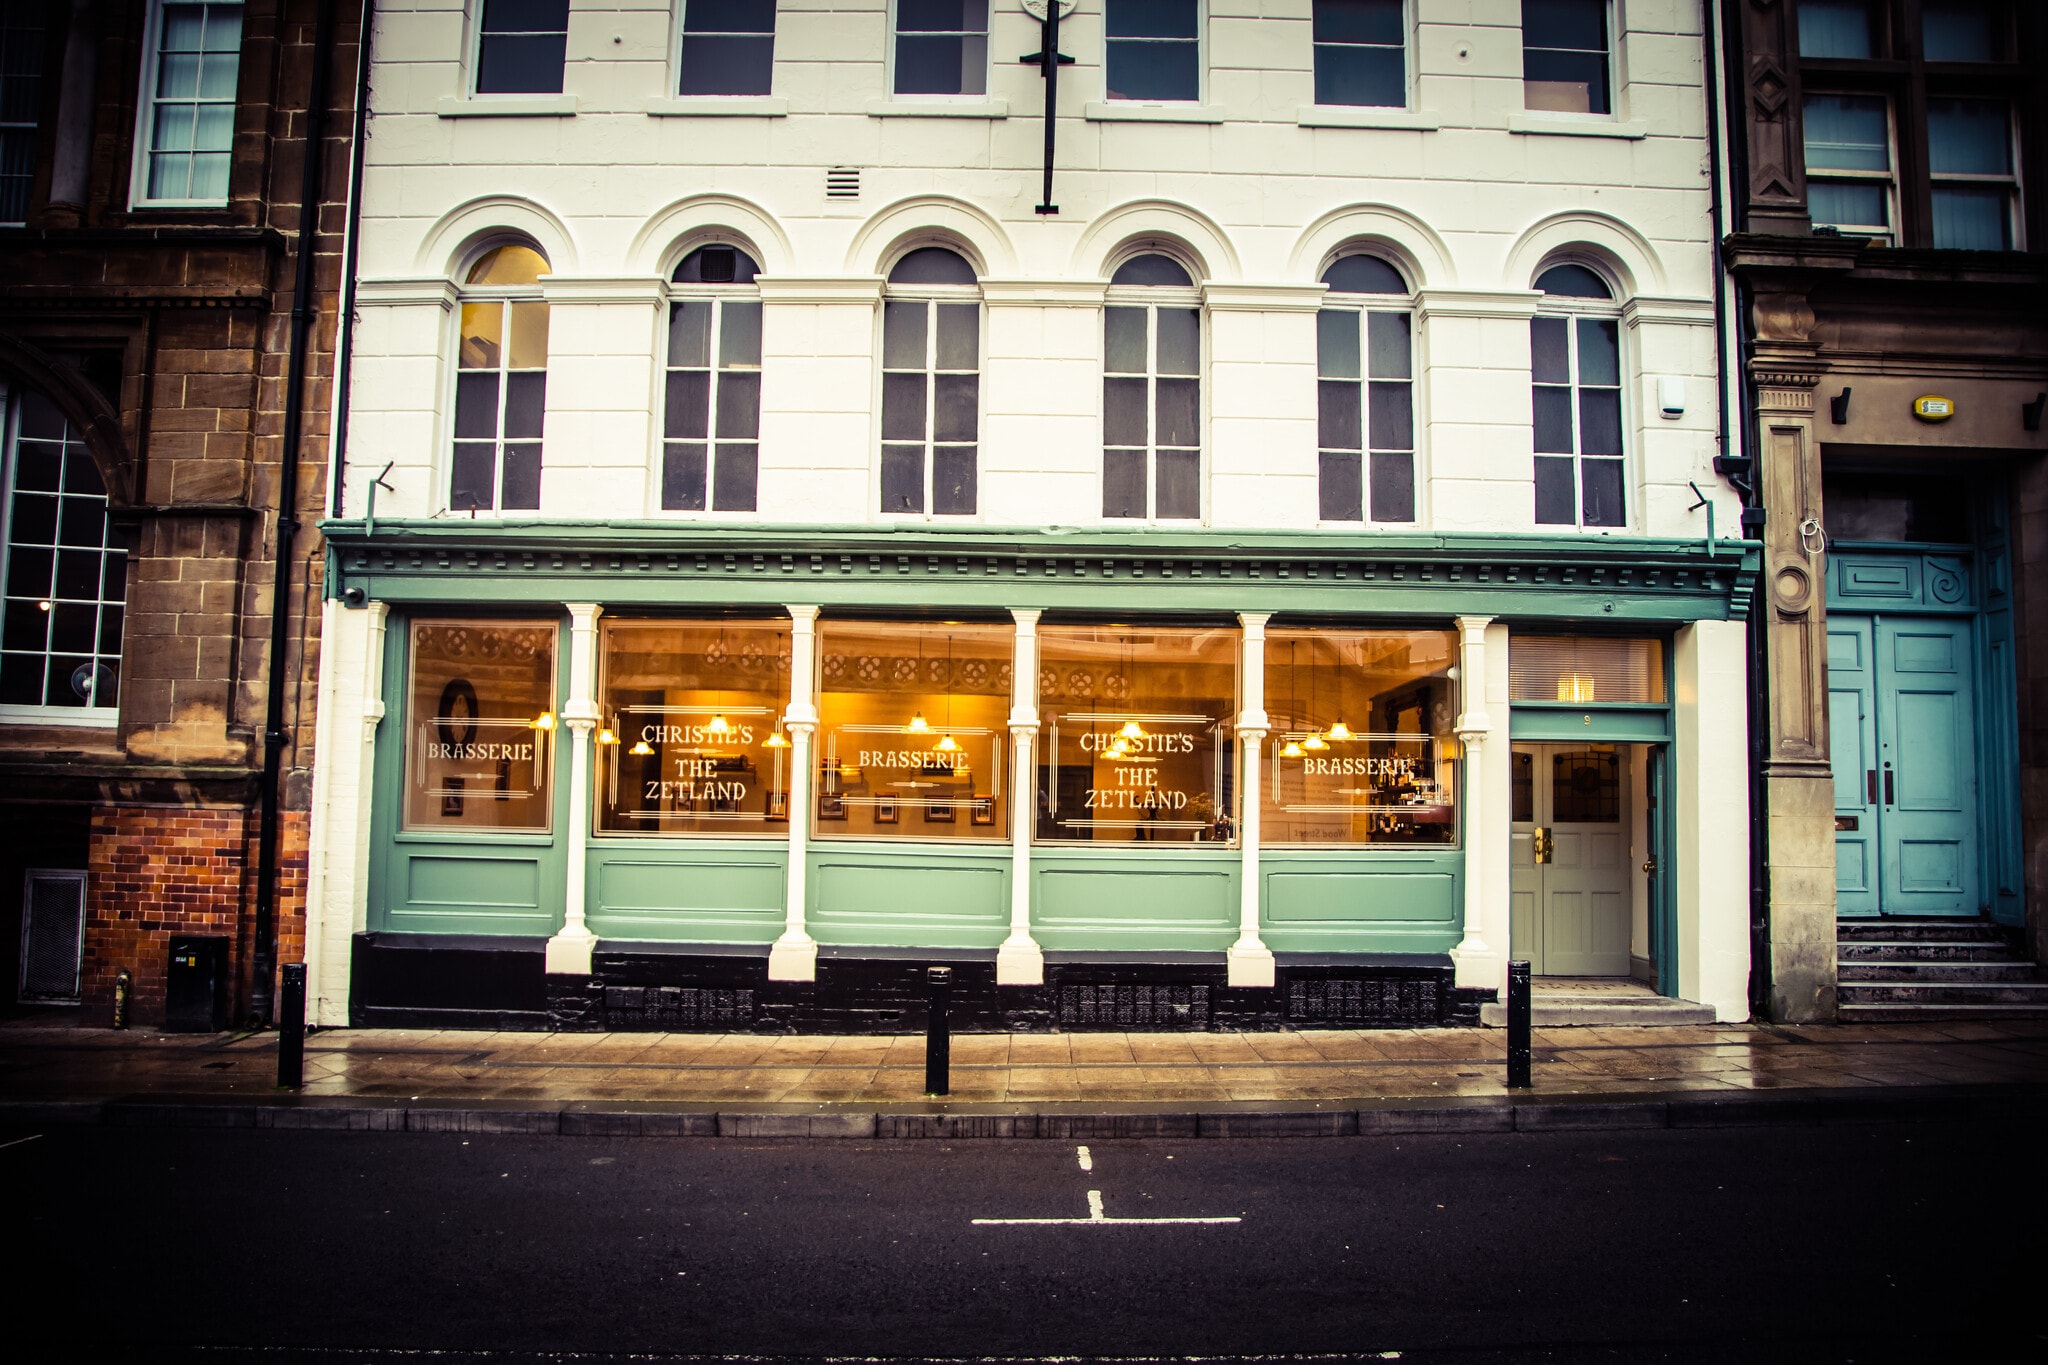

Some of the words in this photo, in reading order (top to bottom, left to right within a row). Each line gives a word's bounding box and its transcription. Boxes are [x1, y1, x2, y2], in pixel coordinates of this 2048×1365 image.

[1584, 715, 1591, 728] 9
[428, 742, 533, 761] BRASSERIE
[1079, 731, 1195, 754] CHSTIE'S
[675, 758, 718, 779] THE
[859, 750, 969, 769] BRASSERIE
[1303, 757, 1412, 776] BRASSERIE
[1114, 766, 1159, 787] THE
[645, 780, 747, 801] ZETLAND
[1084, 788, 1188, 810] ZETLAND
